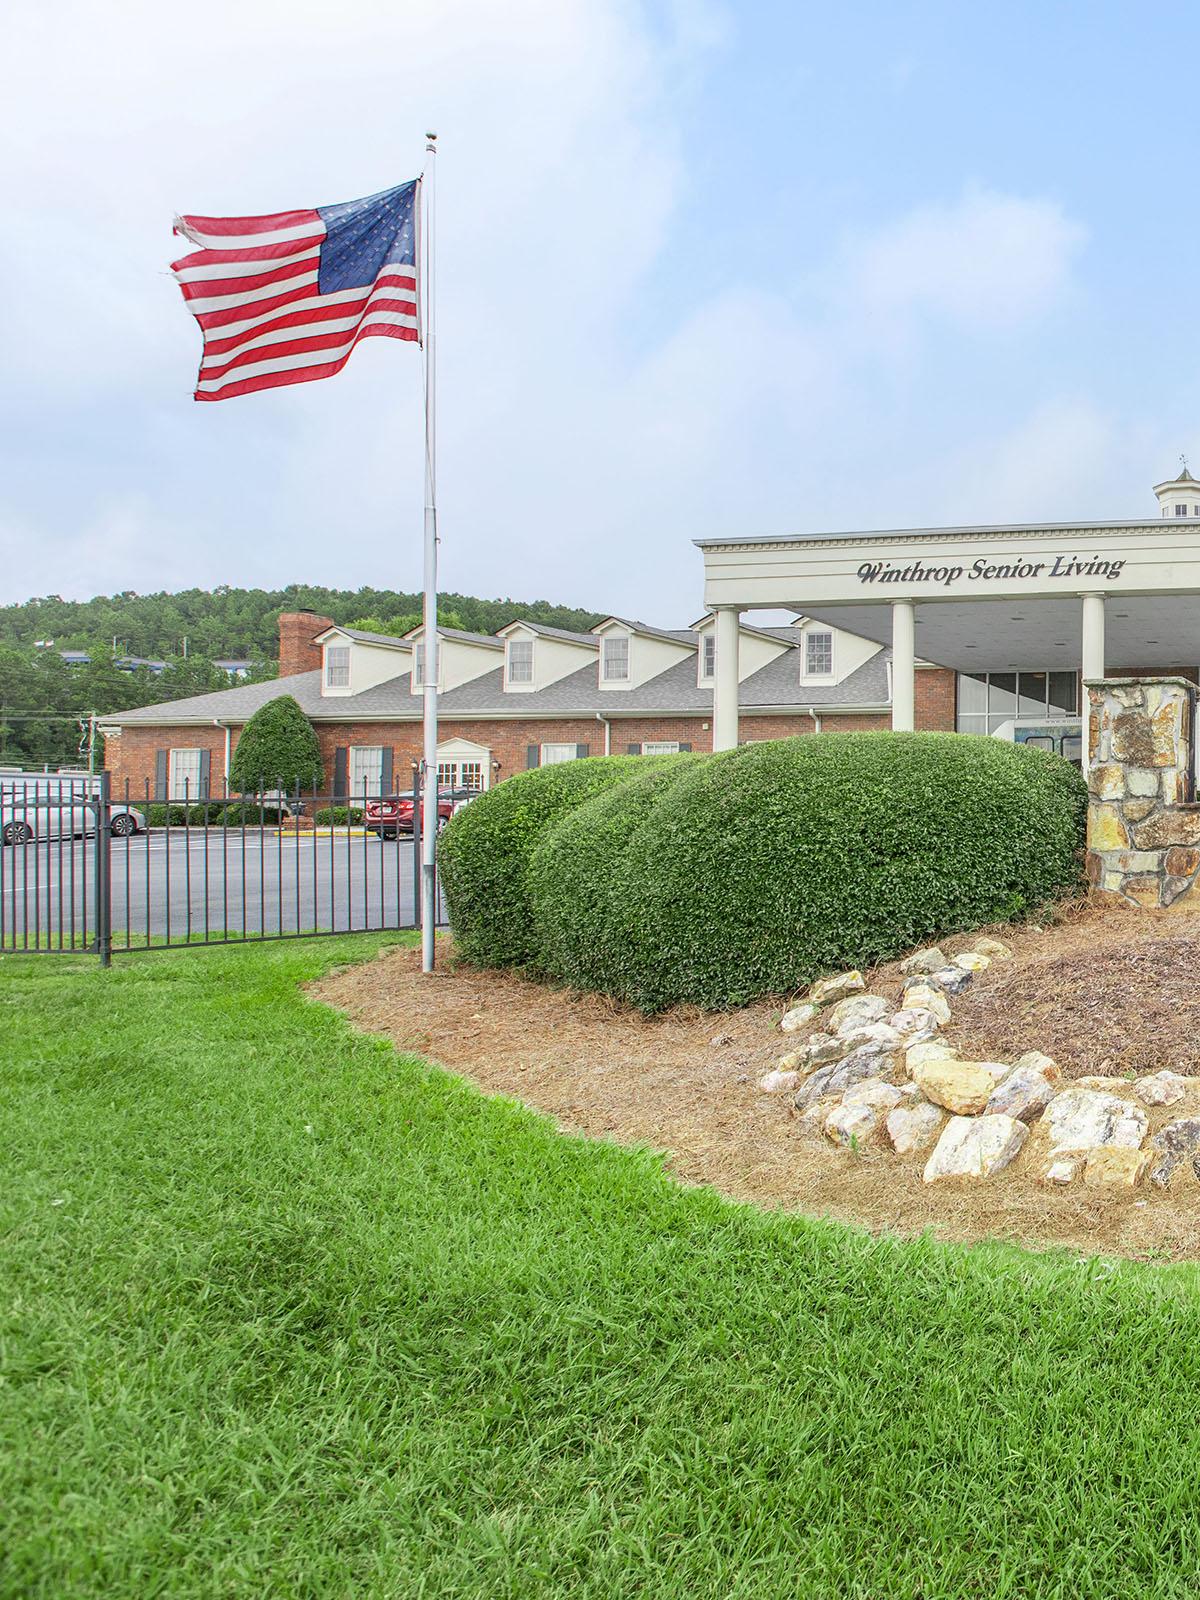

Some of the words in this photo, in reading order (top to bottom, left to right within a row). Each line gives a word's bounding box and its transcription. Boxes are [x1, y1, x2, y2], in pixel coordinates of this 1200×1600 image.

[857, 561, 963, 585] Winthrop
[967, 558, 1046, 580] Senior
[1048, 555, 1127, 579] Living
